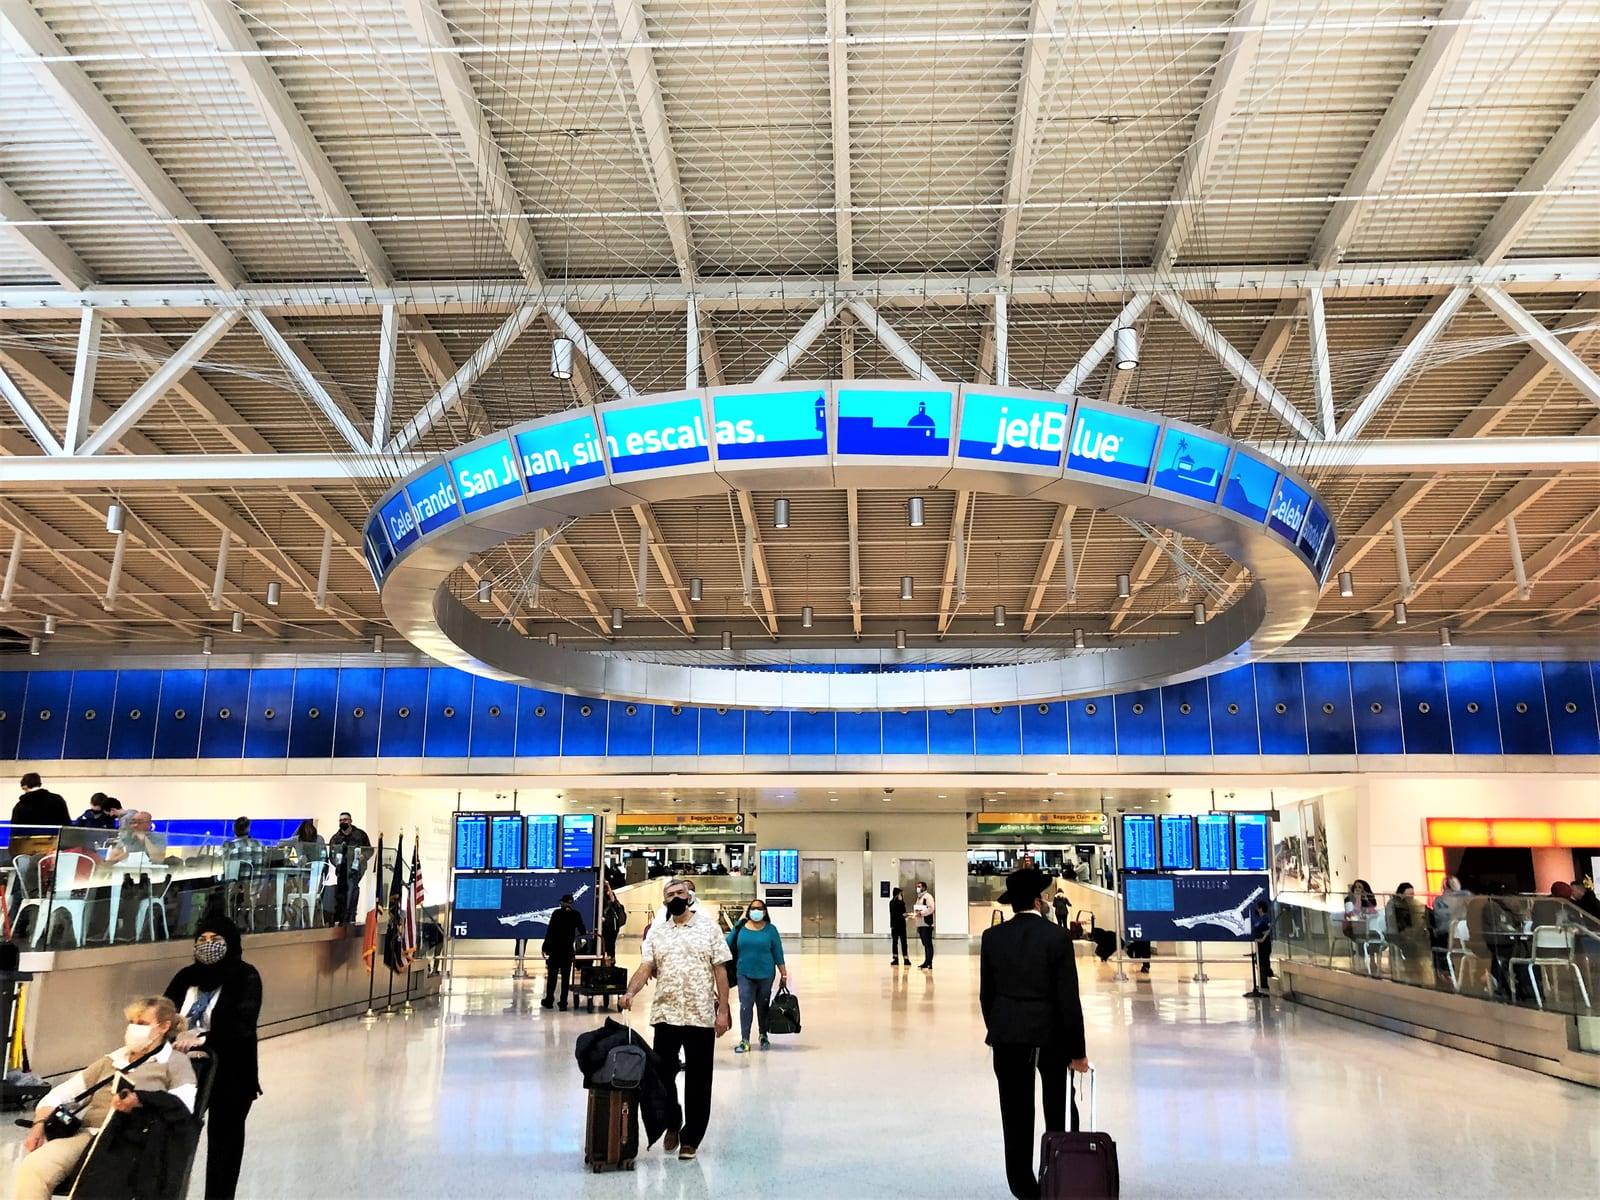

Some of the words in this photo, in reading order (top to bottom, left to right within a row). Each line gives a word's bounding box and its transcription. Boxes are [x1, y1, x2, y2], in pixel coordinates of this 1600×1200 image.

[459, 468, 499, 499] San
[502, 447, 570, 486] Juan,
[572, 432, 620, 466] sin
[626, 415, 765, 456] escalas.
[991, 406, 1120, 463] jetBlue
[1128, 927, 1142, 938] T5
